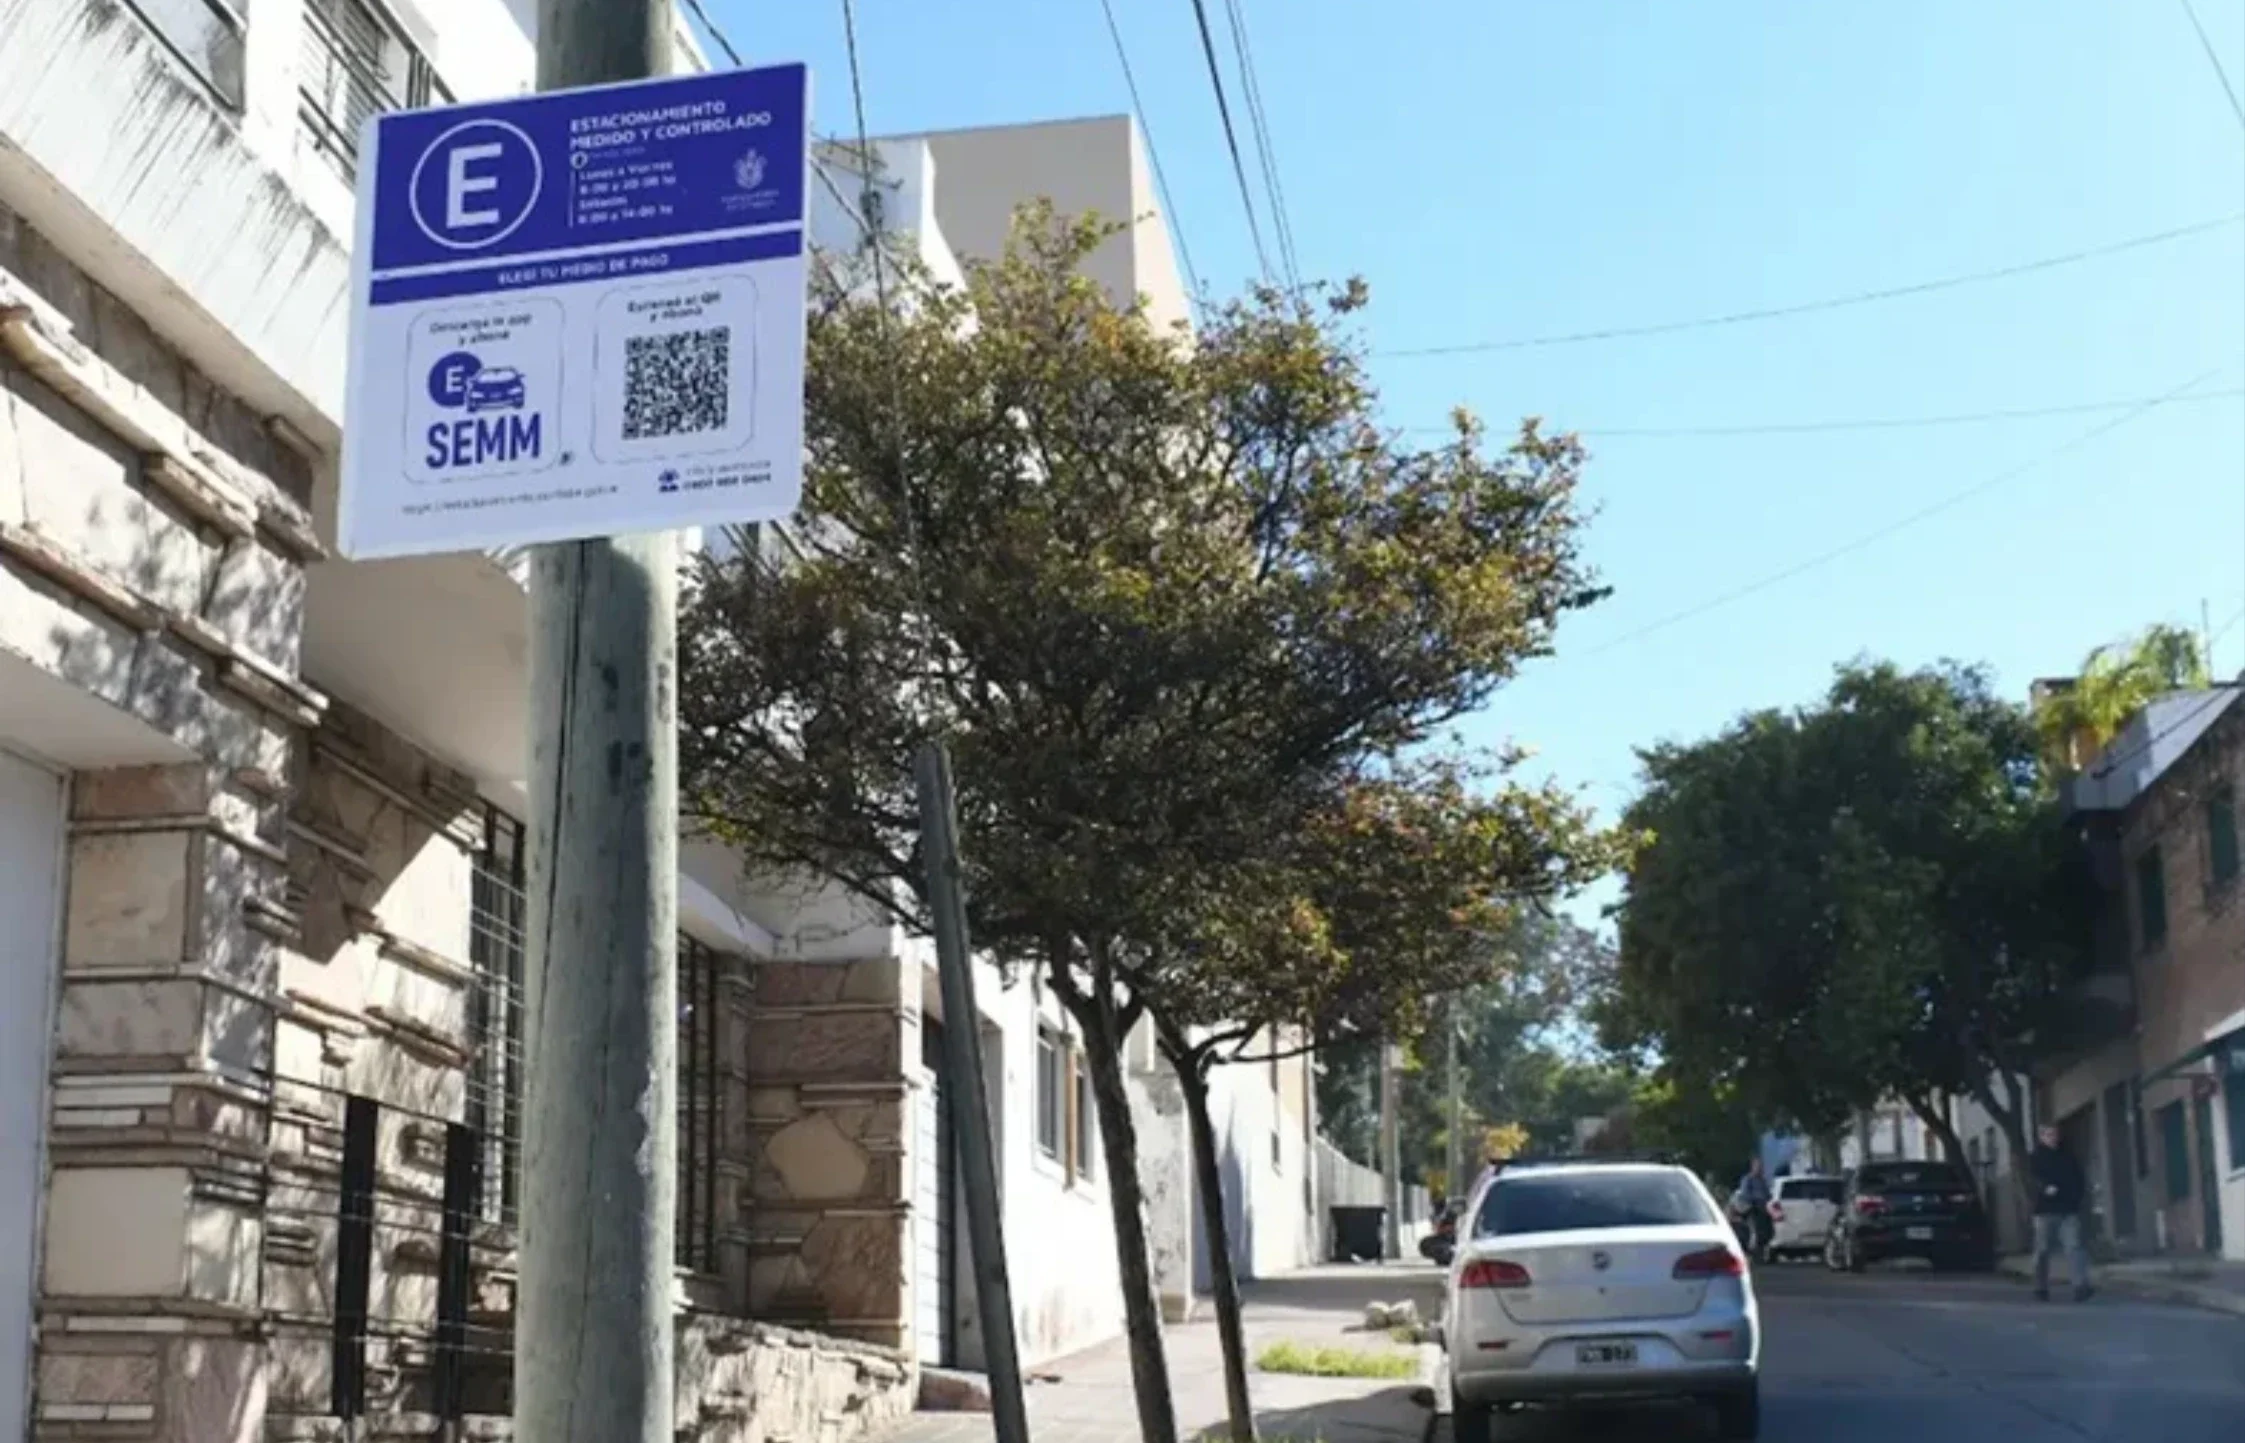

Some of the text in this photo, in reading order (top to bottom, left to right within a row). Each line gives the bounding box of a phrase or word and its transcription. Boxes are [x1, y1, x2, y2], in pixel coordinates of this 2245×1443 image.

[570, 100, 727, 133] ESTACIONAMIENTO
[570, 111, 772, 151] MEDIDO Y CONTROLADO
[446, 143, 503, 229] E
[609, 257, 627, 272] DE
[446, 365, 465, 394] E
[426, 411, 541, 470] SEMM
